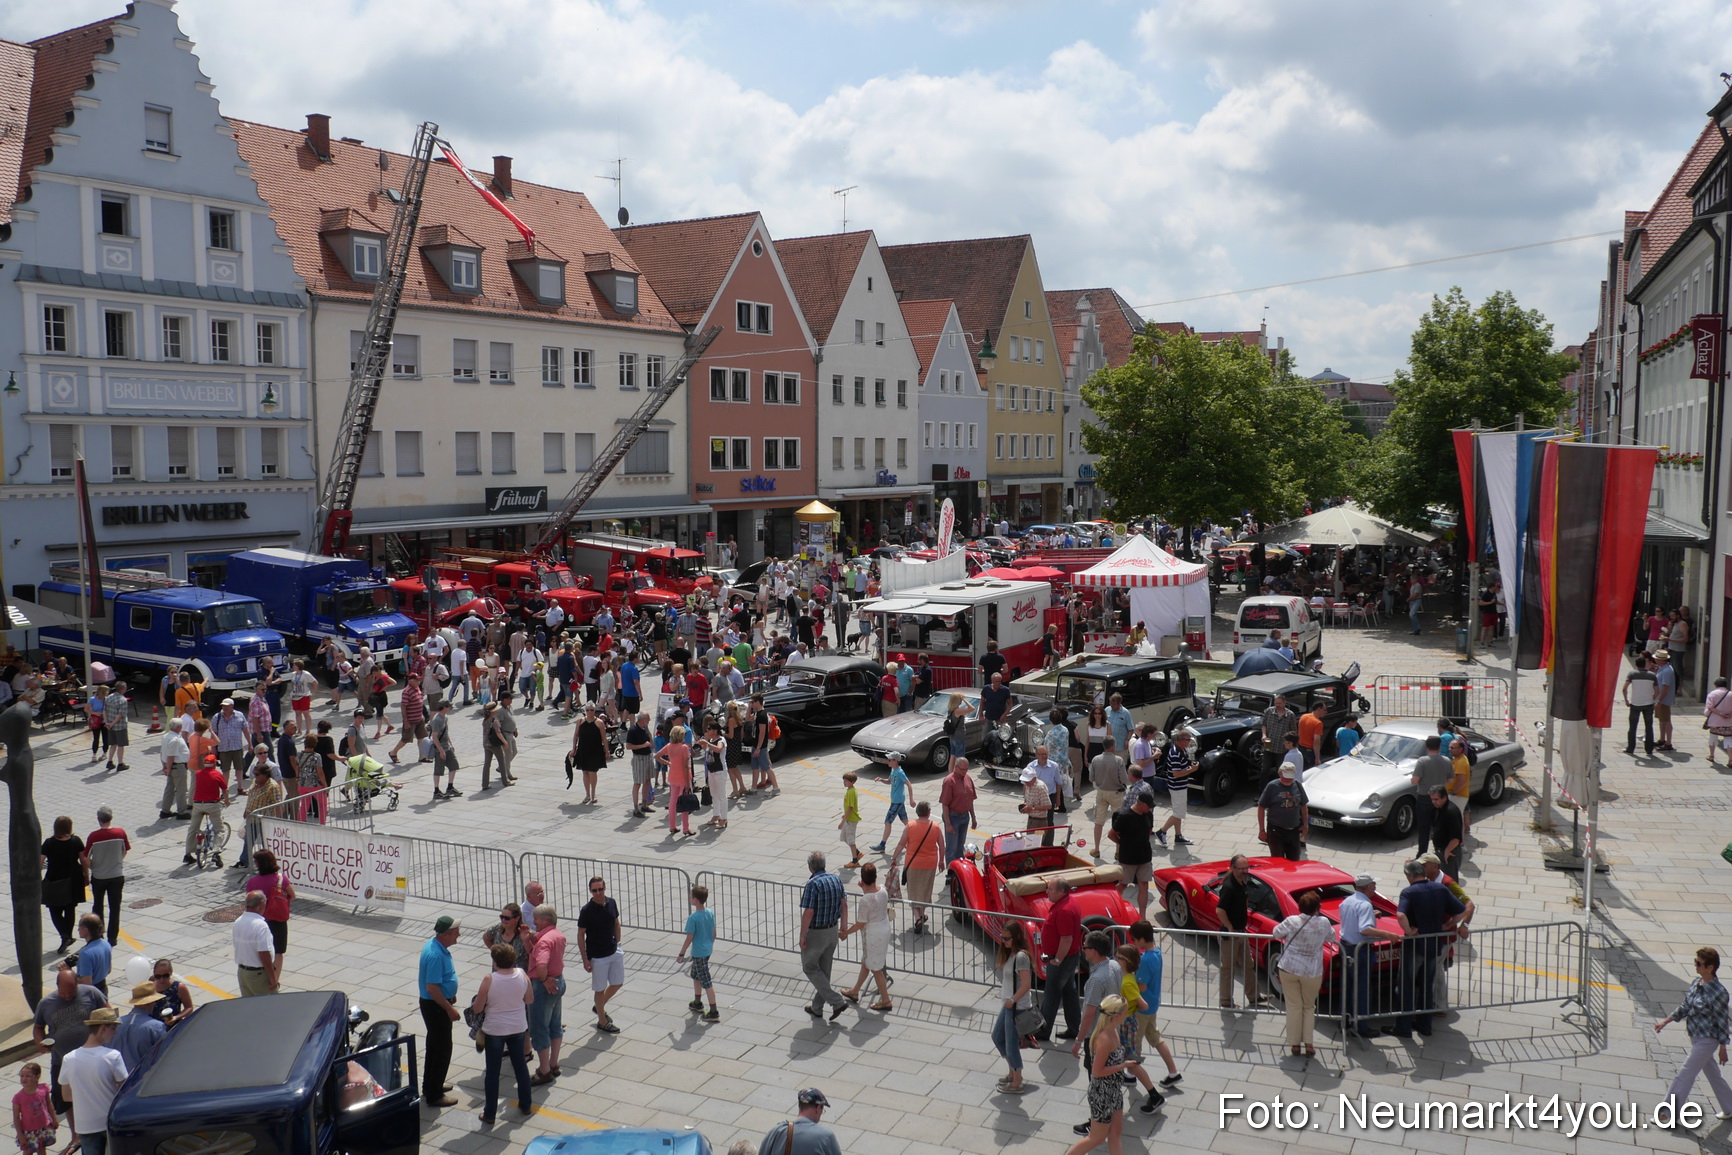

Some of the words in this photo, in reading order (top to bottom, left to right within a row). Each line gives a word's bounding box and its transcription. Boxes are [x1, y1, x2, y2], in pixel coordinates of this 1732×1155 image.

[1697, 328, 1715, 375] Achatz
[113, 382, 177, 400] BRILLEN
[180, 384, 235, 402] WEBER
[490, 489, 546, 511] frühauf
[102, 504, 179, 526] BRILLEN
[181, 501, 250, 522] WEBER
[372, 621, 395, 629] THW
[273, 827, 290, 839] ADAC
[266, 838, 363, 868] FRIEDENFELSER
[375, 860, 393, 874] 2015
